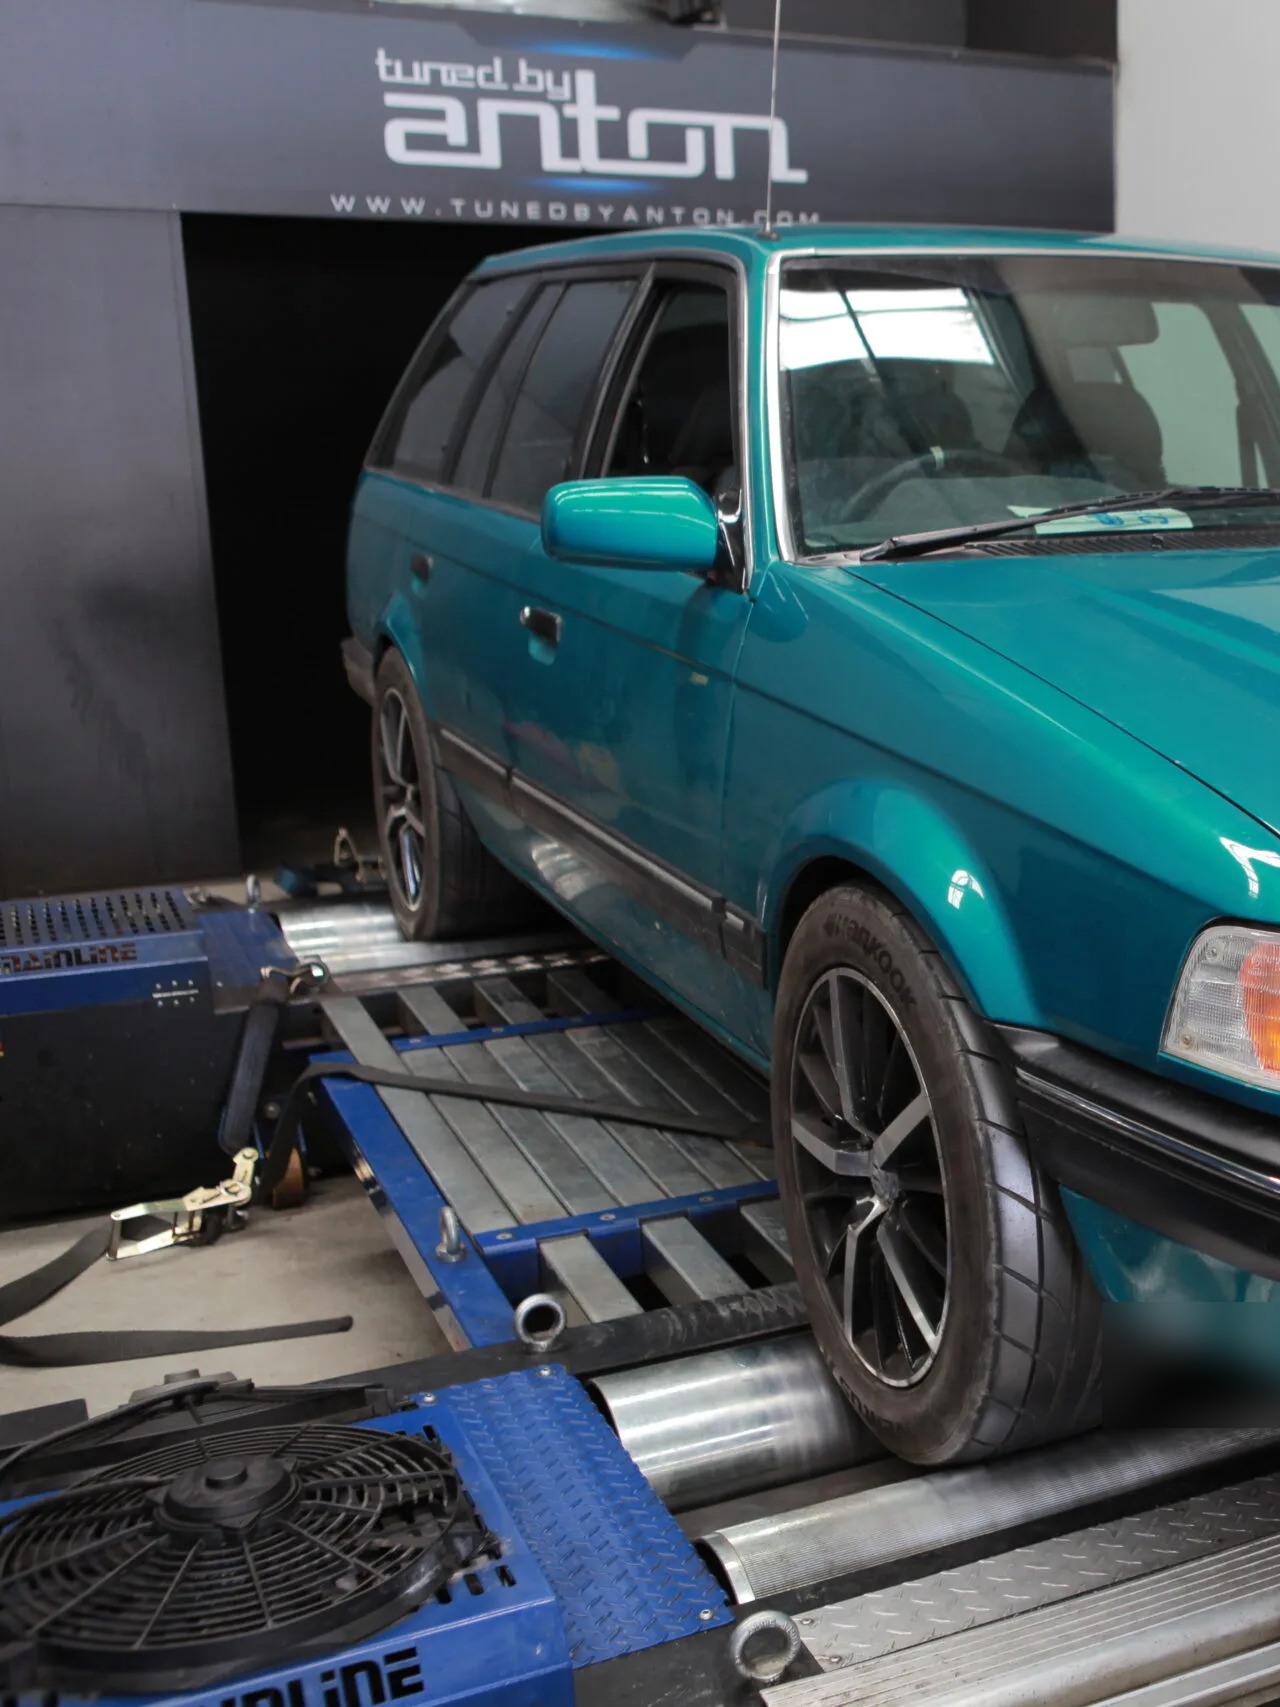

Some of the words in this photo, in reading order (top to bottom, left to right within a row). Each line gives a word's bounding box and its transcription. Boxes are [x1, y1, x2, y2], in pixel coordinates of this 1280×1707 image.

[375, 47, 509, 90] tuned
[512, 57, 571, 101] by
[383, 69, 808, 184] anton
